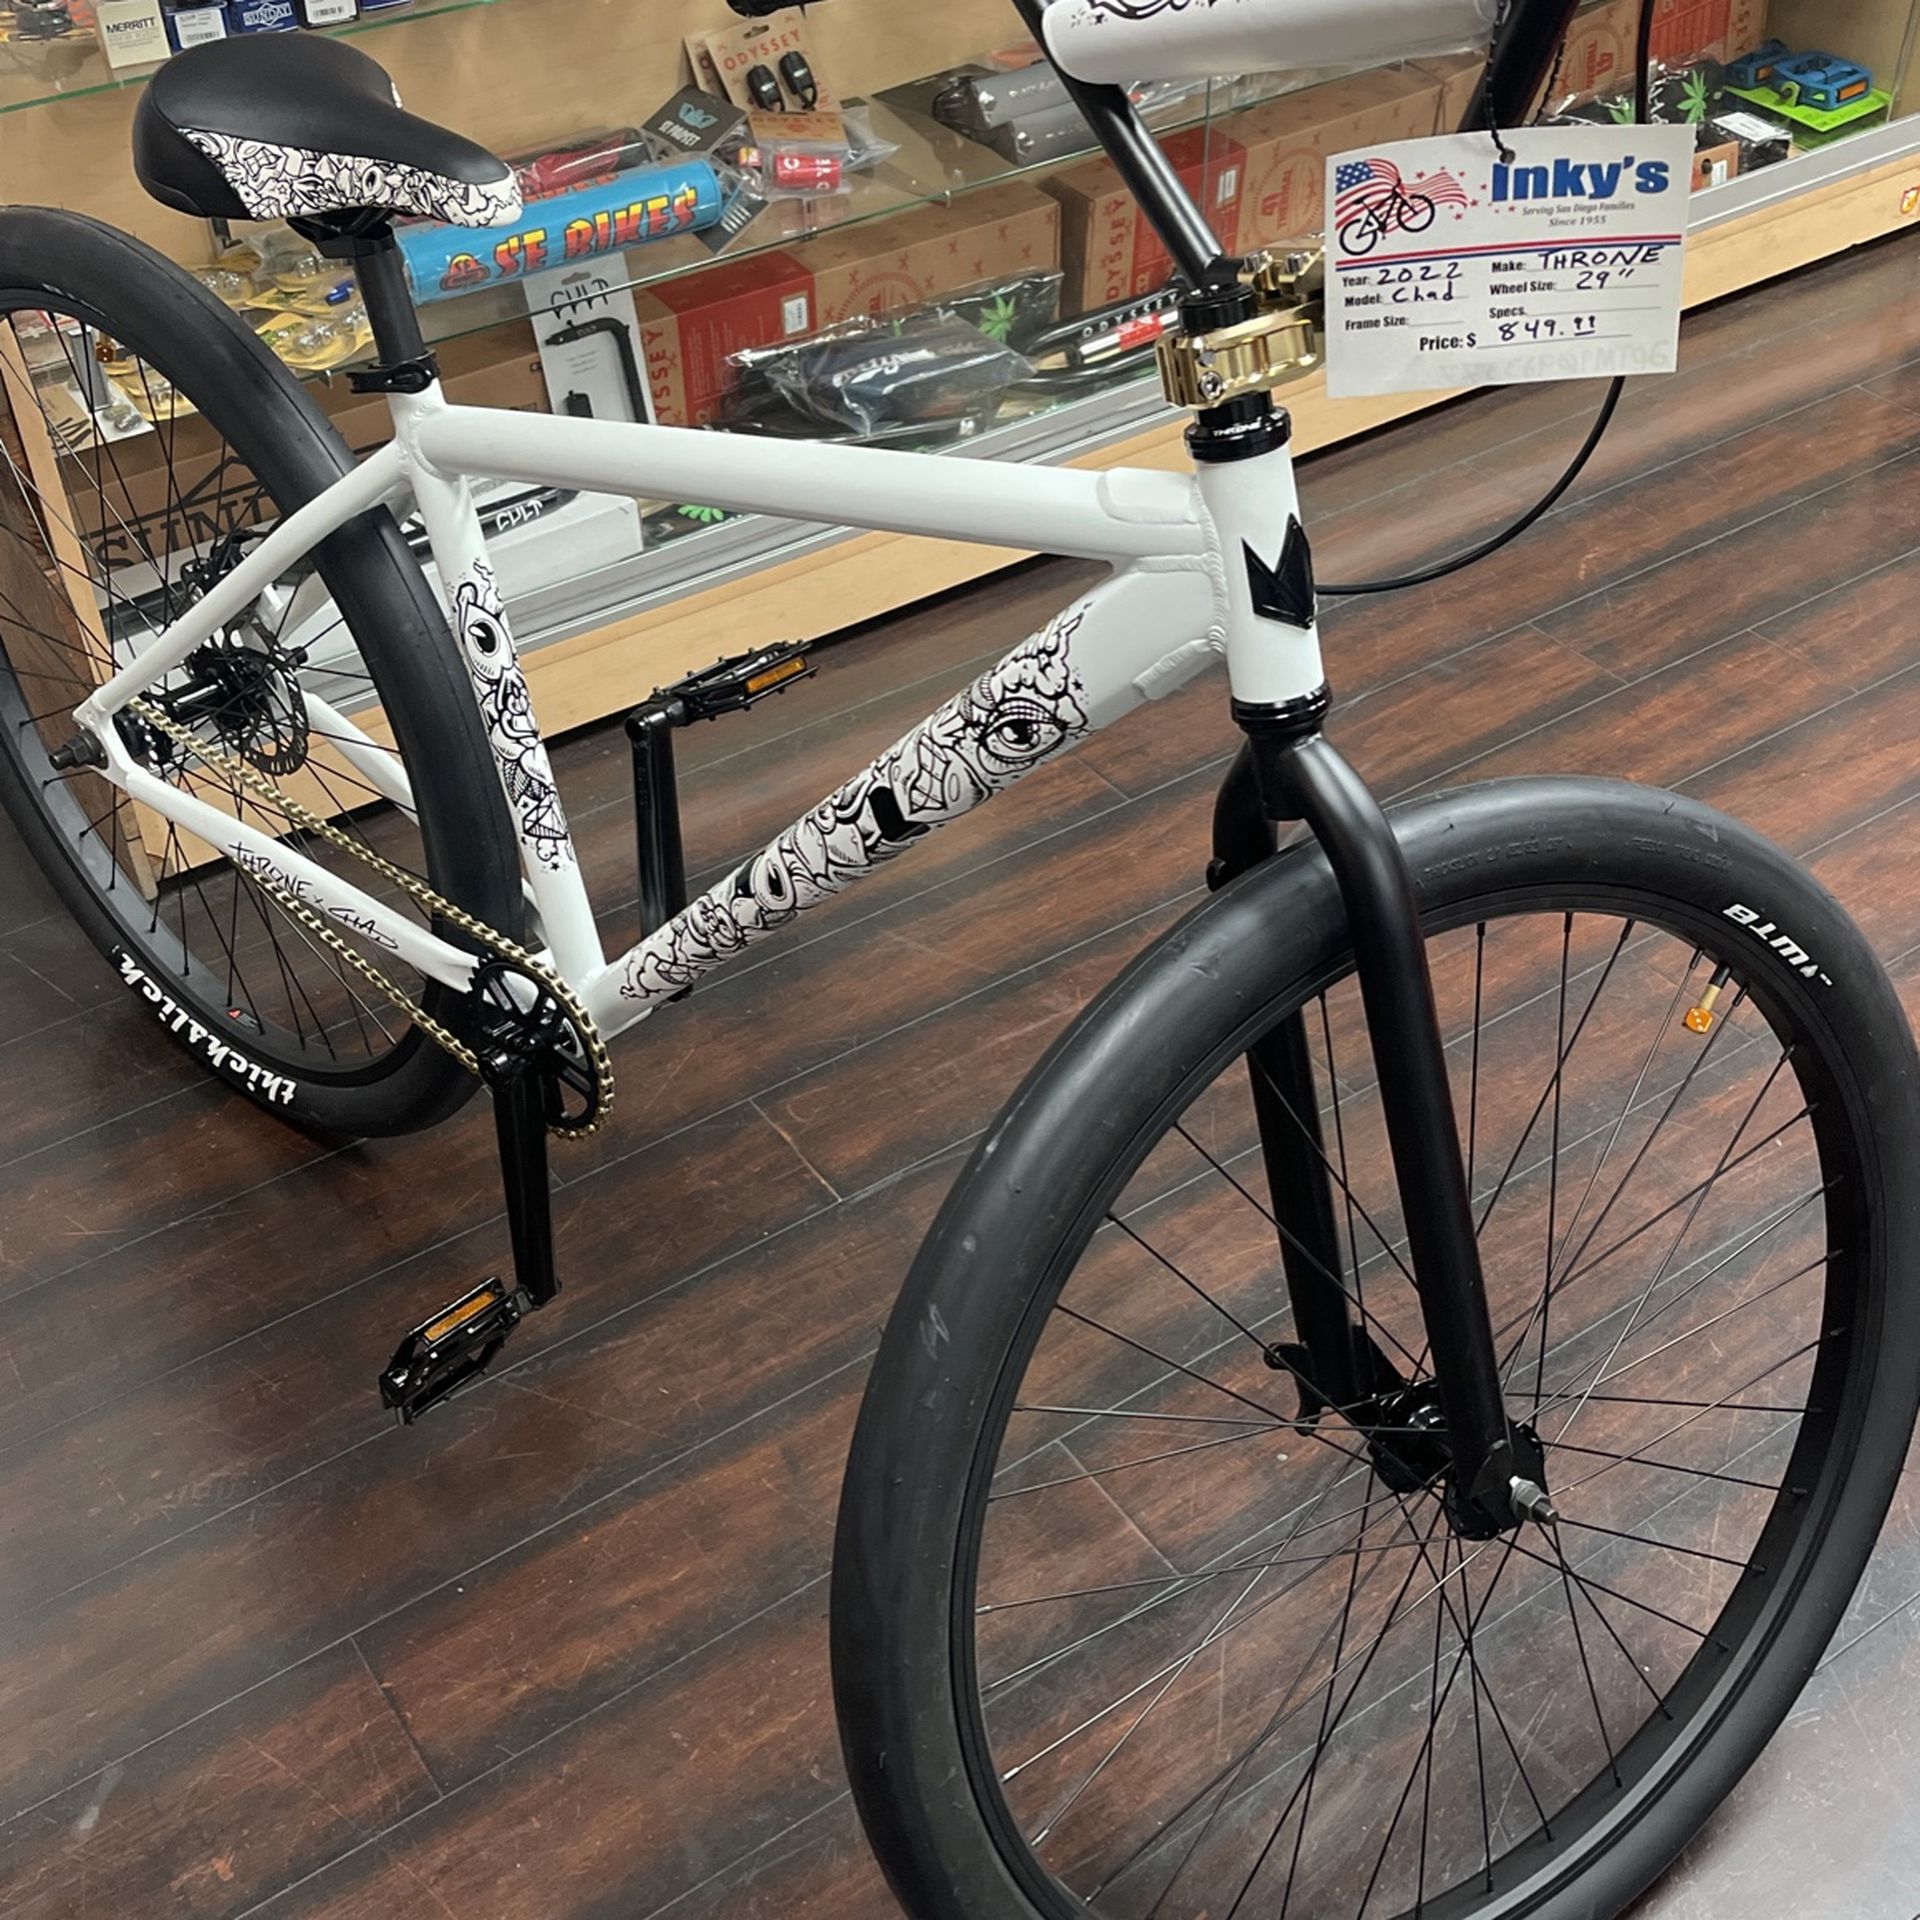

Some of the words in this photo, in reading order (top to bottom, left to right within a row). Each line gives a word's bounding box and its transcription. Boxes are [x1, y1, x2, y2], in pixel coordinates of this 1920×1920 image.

[106, 17, 157, 34] MERRITT
[244, 4, 293, 26] SUNDAY
[723, 29, 800, 71] ODYSSEY
[1492, 156, 1669, 202] Inky's
[1522, 206, 1554, 216] Serving
[1556, 204, 1571, 213] San
[1573, 203, 1598, 213] Diego
[1599, 201, 1635, 211] Families
[1549, 218, 1577, 227] Since
[1580, 215, 1607, 226] 1955
[494, 228, 548, 279] SE
[564, 186, 699, 261] BIKES
[1104, 198, 1127, 300] DYSSEY
[1491, 260, 1527, 273] Make:
[1537, 243, 1665, 270] THRONE
[1377, 262, 1463, 286] 2022
[1490, 282, 1528, 296] Wheel
[1530, 280, 1556, 292] Size:
[551, 278, 609, 320] CULT
[1391, 280, 1454, 303] Chad
[1081, 293, 1179, 339] ODYSSEY
[1344, 318, 1380, 331] Frame
[1383, 315, 1409, 328] Size:
[1420, 336, 1463, 351] Price:
[1466, 332, 1477, 348] $
[645, 329, 671, 420] YSSEY
[496, 499, 543, 531] CULT
[228, 841, 313, 898] THRONE
[328, 907, 399, 949] CHAD
[119, 953, 297, 1105] thickslick
